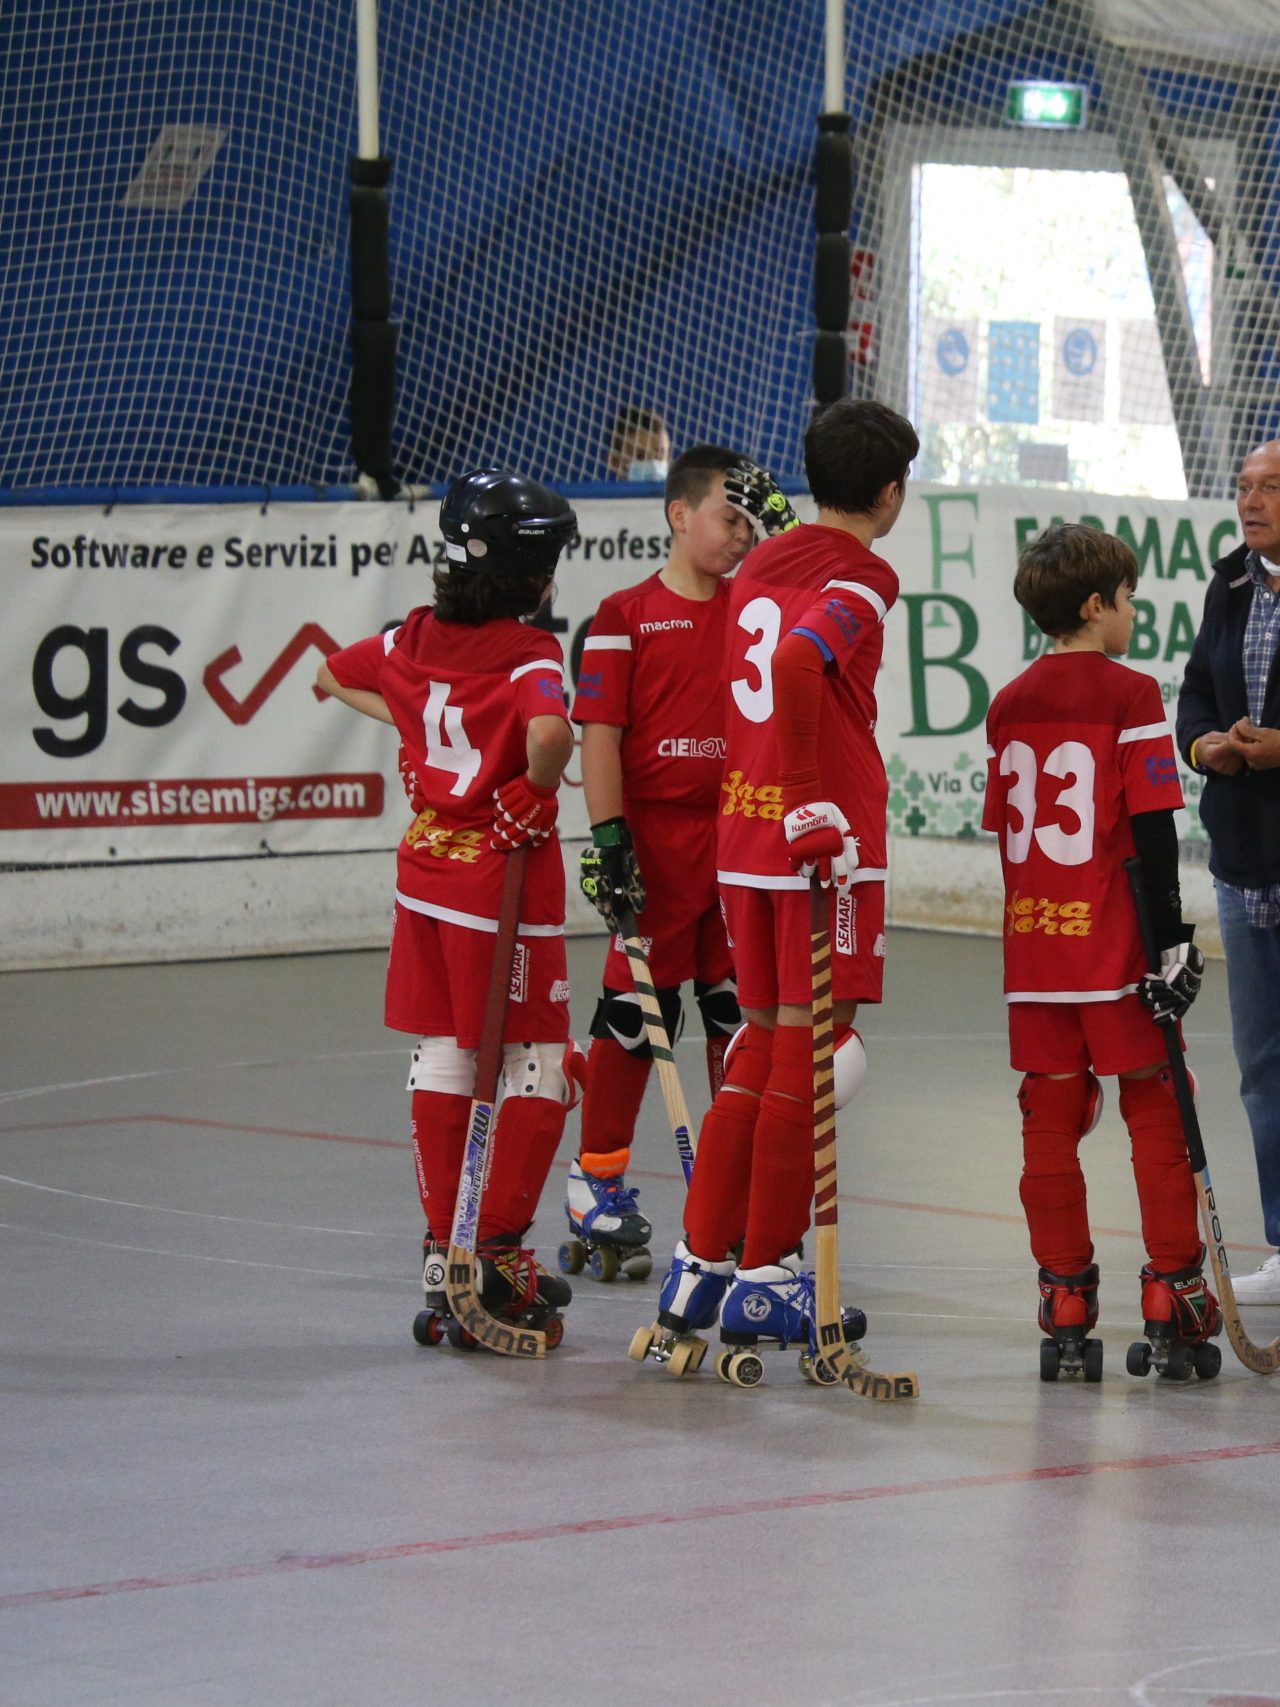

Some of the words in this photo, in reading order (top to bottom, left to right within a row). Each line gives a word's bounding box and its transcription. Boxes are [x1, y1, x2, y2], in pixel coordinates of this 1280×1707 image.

[31, 535, 187, 569] Software
[196, 543, 214, 568] e
[225, 535, 337, 569] Servizi
[640, 618, 693, 634] macron
[32, 624, 187, 758] gs
[422, 680, 482, 797] 4
[36, 778, 366, 821] www.sistemigs.com
[928, 771, 962, 793] Via
[999, 740, 1096, 866] 33
[838, 896, 851, 949] SEMAR
